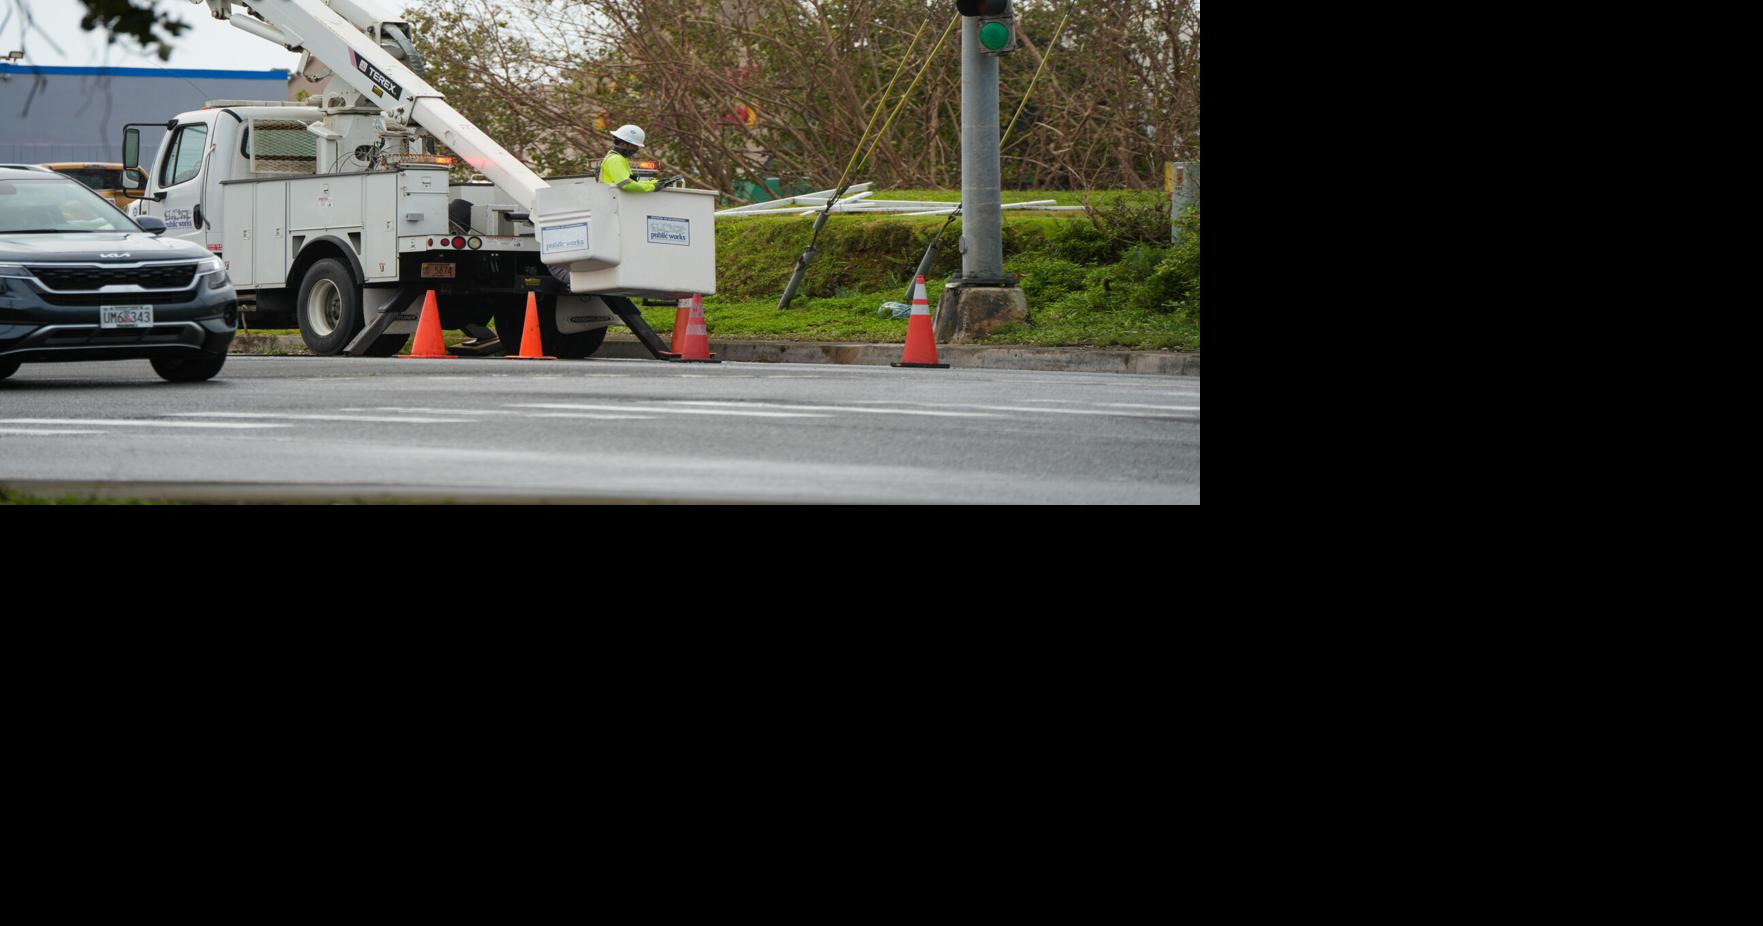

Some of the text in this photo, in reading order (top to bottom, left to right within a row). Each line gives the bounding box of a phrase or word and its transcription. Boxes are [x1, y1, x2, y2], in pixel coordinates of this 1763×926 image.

[369, 67, 396, 94] TEREX
[650, 232, 686, 241] public works
[545, 240, 564, 252] public
